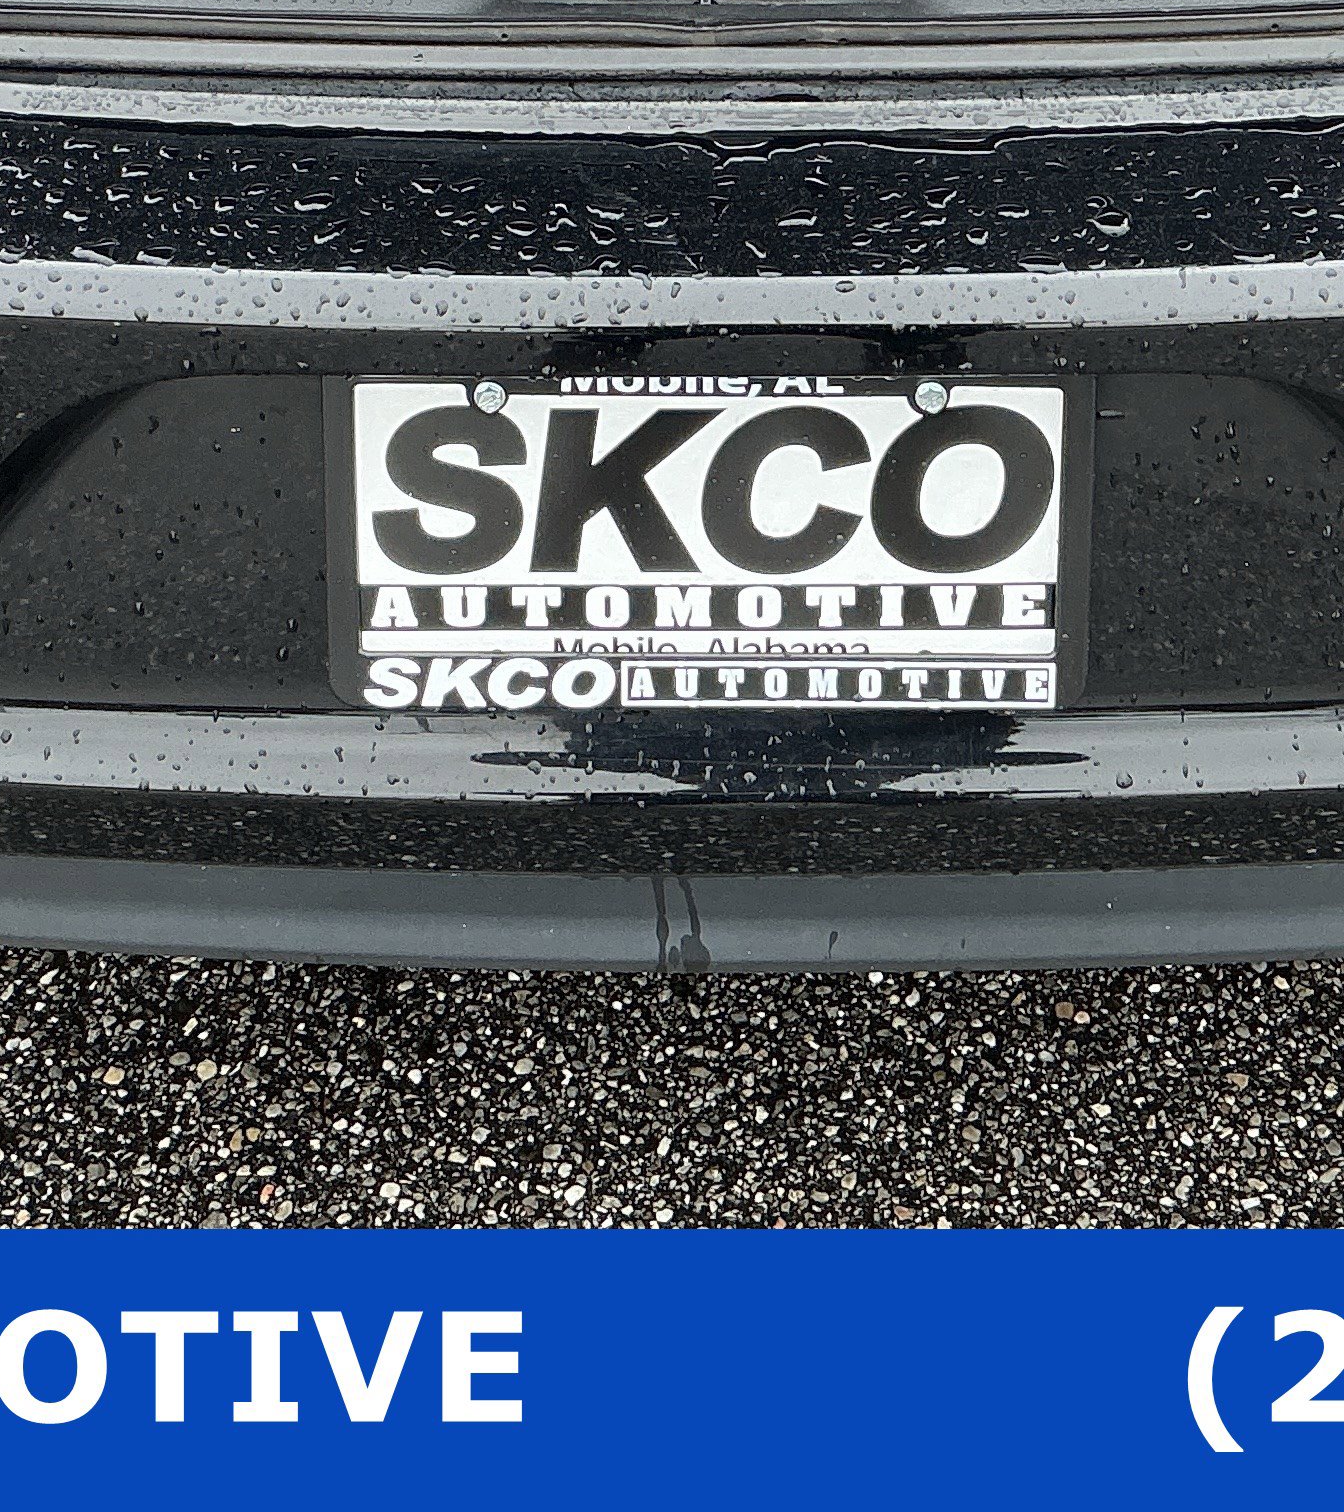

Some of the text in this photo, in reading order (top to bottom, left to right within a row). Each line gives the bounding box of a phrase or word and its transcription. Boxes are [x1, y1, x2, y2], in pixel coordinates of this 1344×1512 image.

[372, 405, 1054, 574] SKCO
[371, 585, 1047, 629] AUTOMOTIVE
[363, 657, 1050, 709] SKCO AUTOMOTIVE
